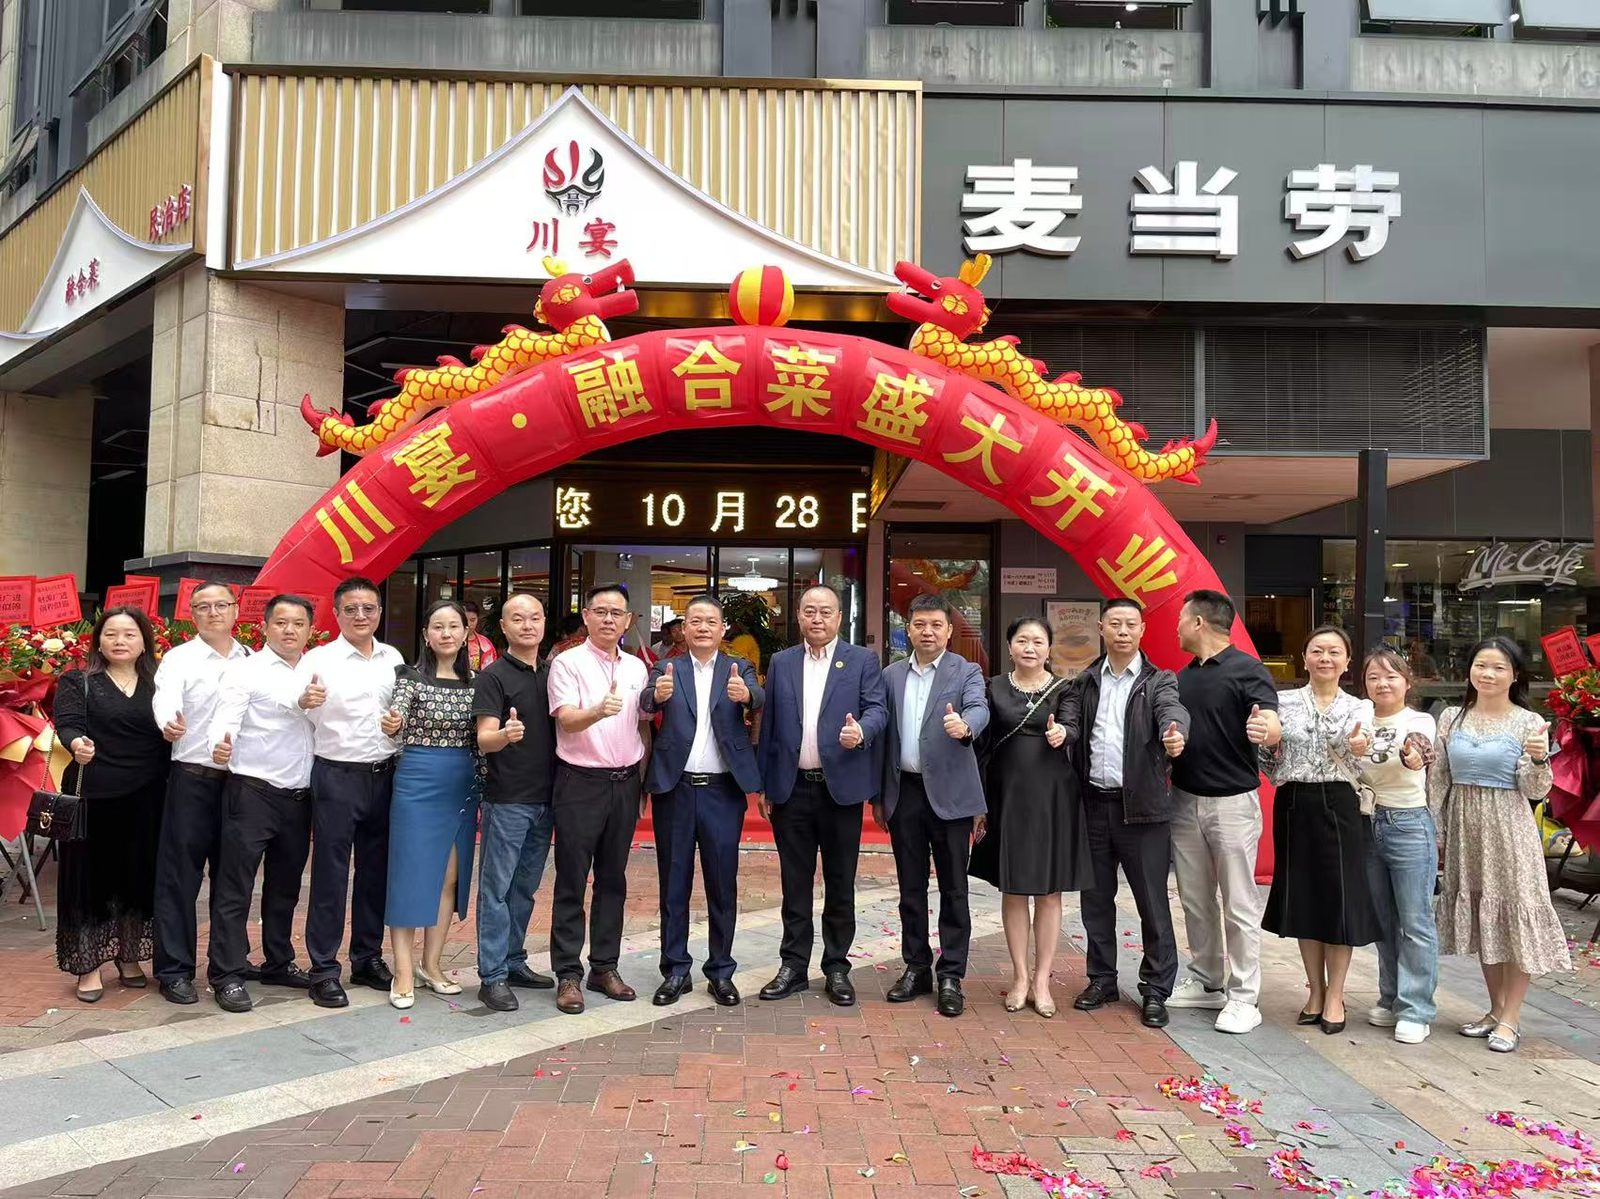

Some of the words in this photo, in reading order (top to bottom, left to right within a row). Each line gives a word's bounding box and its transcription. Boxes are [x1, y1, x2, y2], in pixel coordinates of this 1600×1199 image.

[526, 217, 619, 258] 川宴
[961, 158, 1402, 262] 麦当劳
